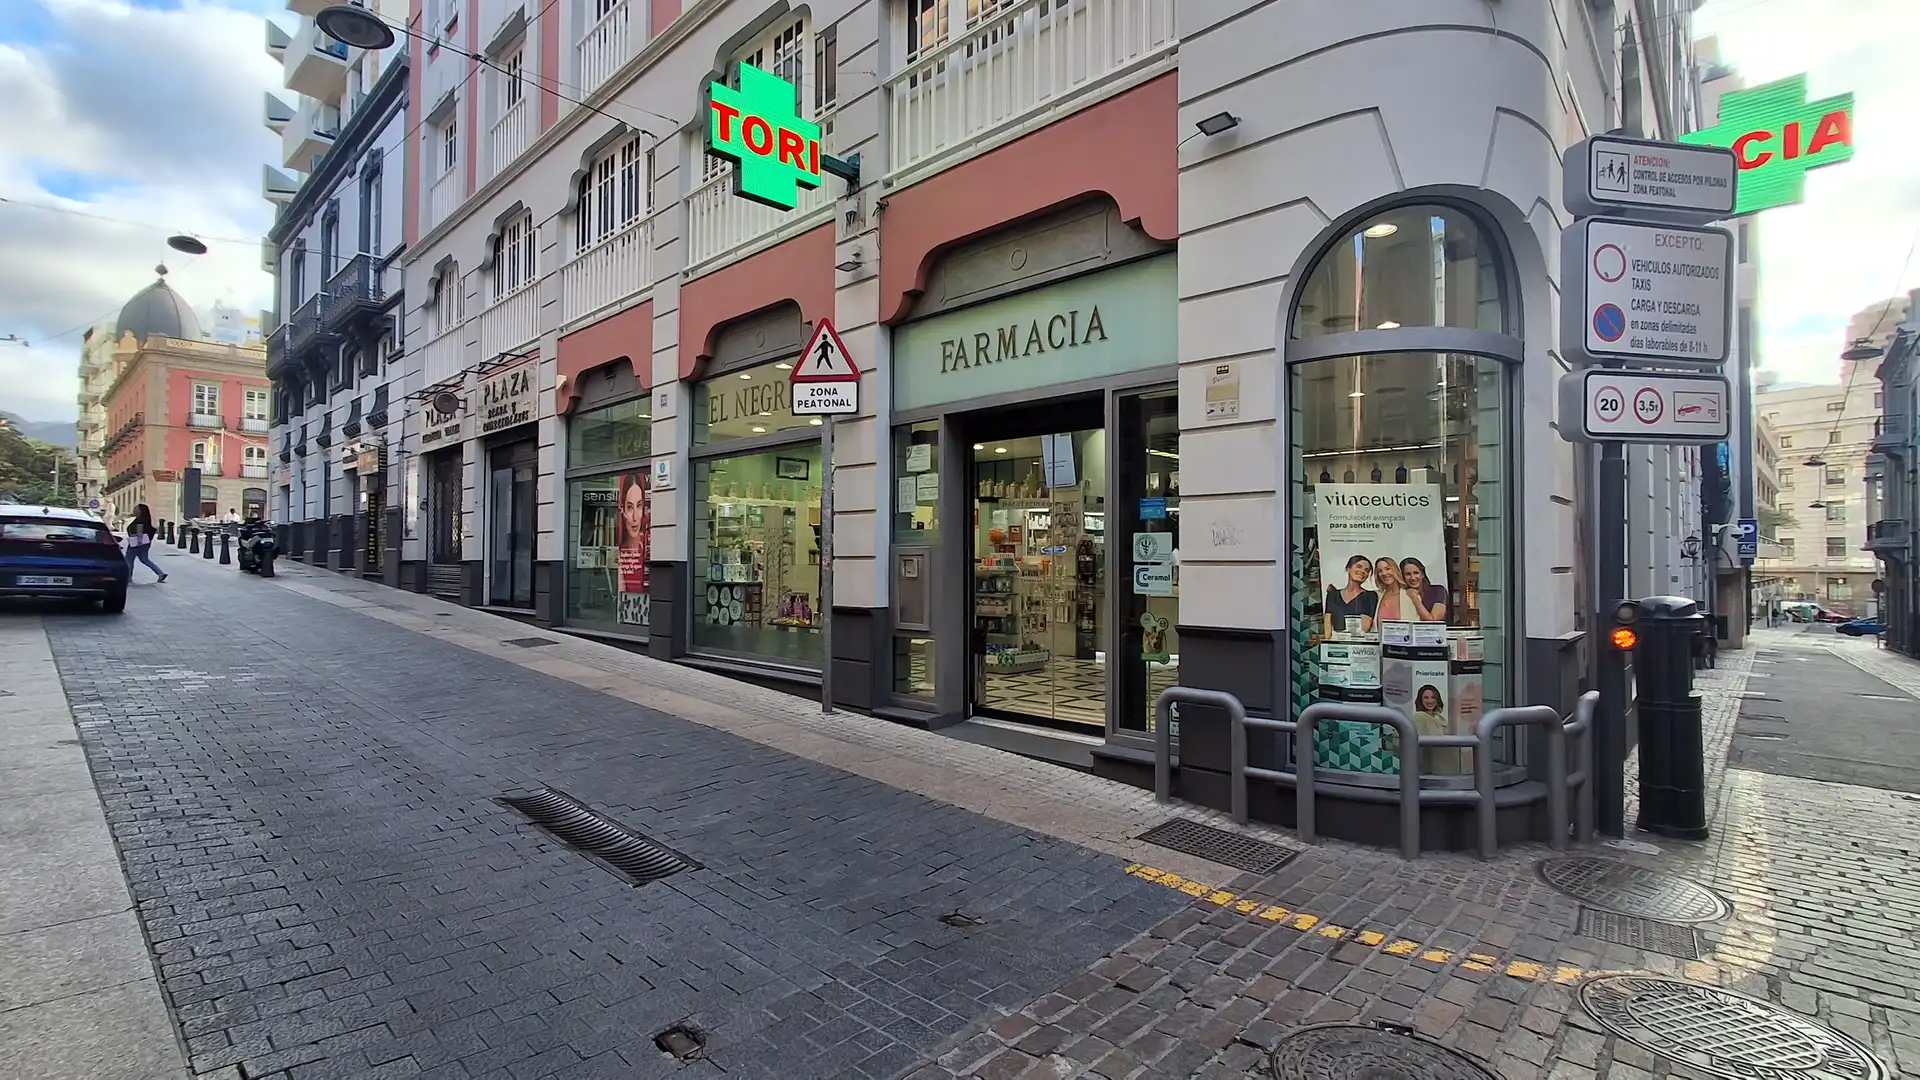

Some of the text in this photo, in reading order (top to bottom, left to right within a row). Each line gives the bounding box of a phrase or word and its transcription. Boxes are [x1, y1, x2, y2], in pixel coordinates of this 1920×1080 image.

[710, 99, 819, 176] TORI
[1633, 169, 1658, 182] CONTROL
[1659, 171, 1667, 183] DE
[1667, 173, 1692, 185] ACCESOS
[1692, 175, 1704, 186] POR
[1633, 184, 1676, 198] ZONA PEATONAL
[1655, 233, 1705, 251] EXCEPTO:
[1672, 263, 1719, 280] AUTORIZADOS
[1631, 277, 1651, 292] TAXIS
[1631, 298, 1701, 316] CARGA Y DESCARGA
[1630, 319, 1640, 330] en
[1640, 320, 1660, 332] zonas
[940, 305, 1109, 374] FARMACIA
[1645, 337, 1679, 352] laborables
[1679, 340, 1688, 353] de
[483, 369, 530, 406] PLAZA
[809, 387, 838, 397] ZONA
[709, 394, 728, 425] EL
[734, 379, 793, 420] NEGR
[797, 399, 852, 409] PEATONAL
[1600, 398, 1618, 412] 20
[1325, 492, 1430, 507] vitaceutics
[1142, 573, 1170, 581] Ceramol
